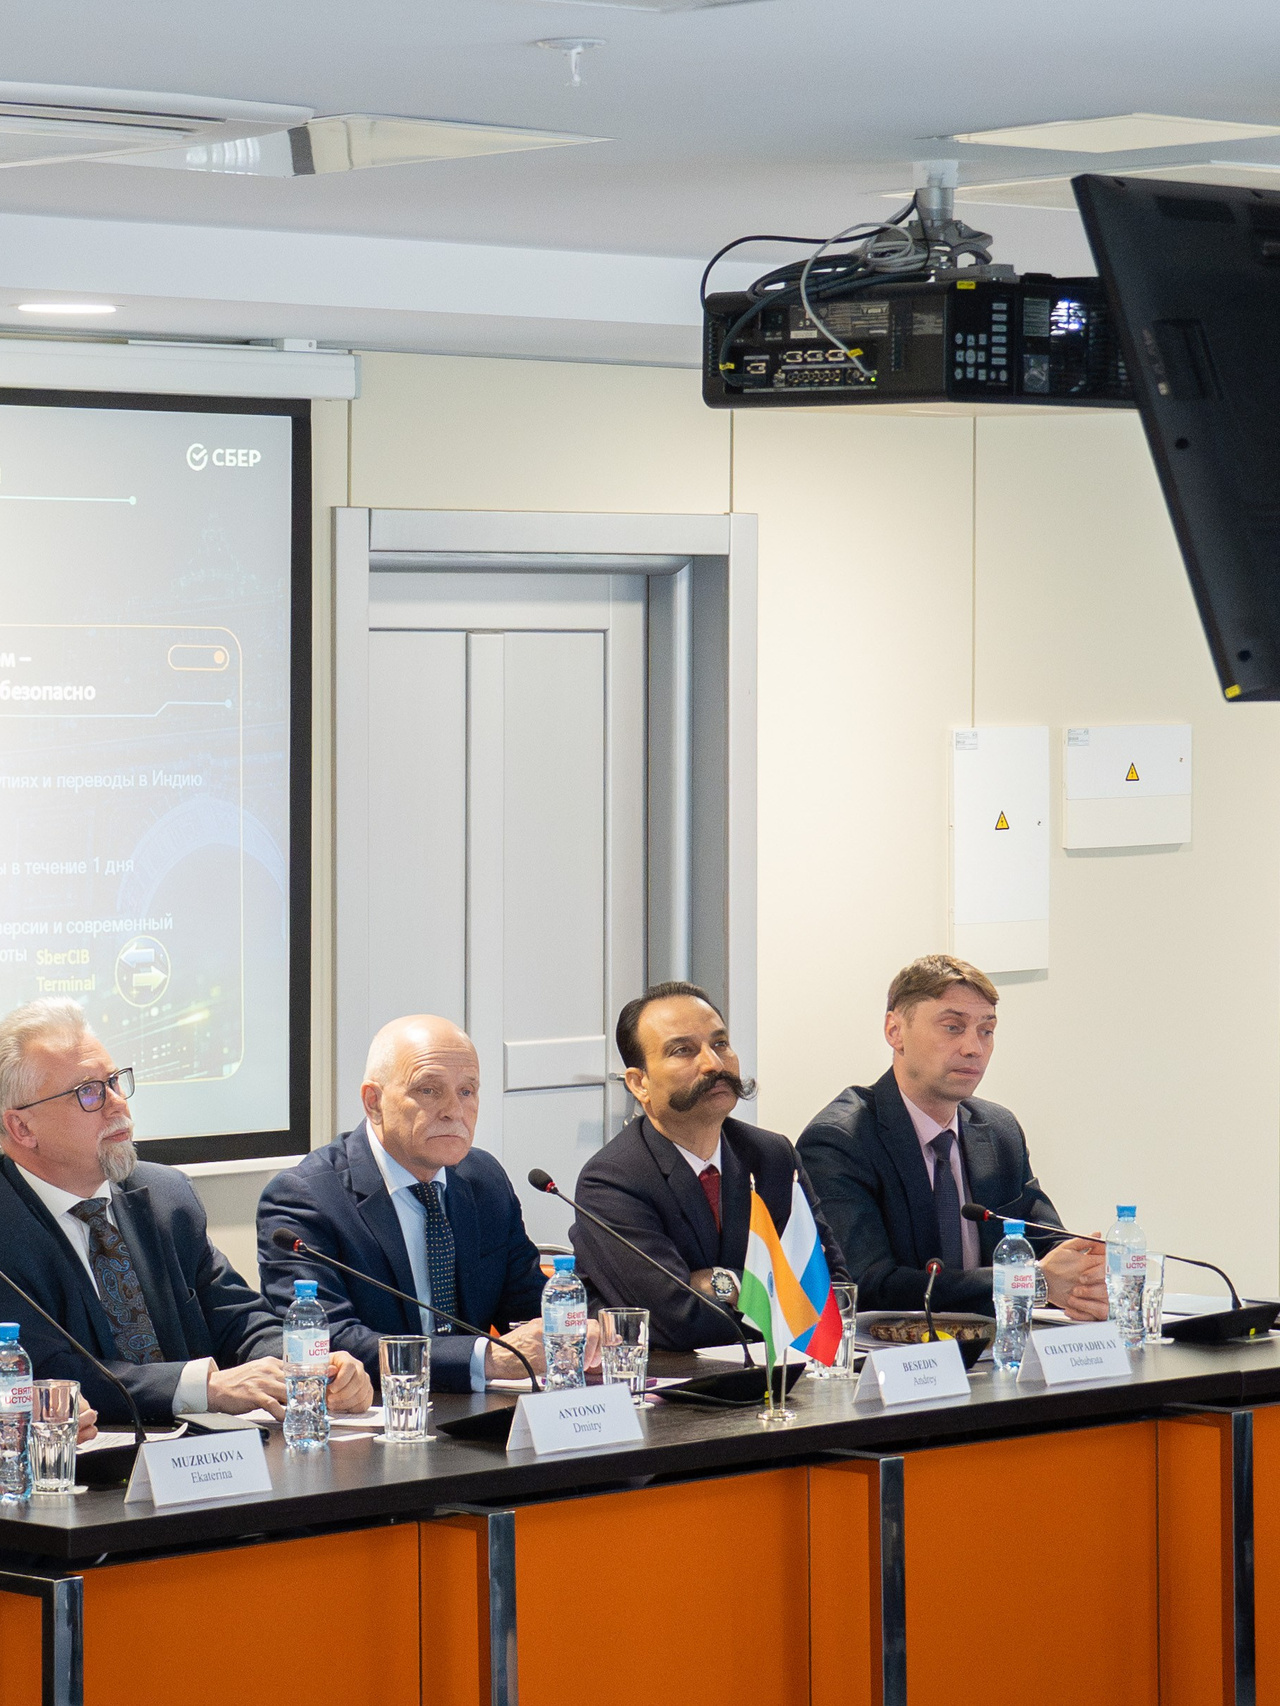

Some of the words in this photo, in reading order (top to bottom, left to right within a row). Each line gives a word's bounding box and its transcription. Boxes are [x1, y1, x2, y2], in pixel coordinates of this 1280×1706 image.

[211, 448, 262, 468] СБЕР
[0, 679, 96, 701] безопасно
[42, 776, 52, 788] и
[56, 773, 135, 793] переводы
[138, 774, 148, 786] в
[152, 769, 202, 788] Индию
[11, 863, 21, 875] в
[24, 859, 87, 875] течение
[92, 856, 101, 874] 1
[104, 858, 135, 876] дня
[53, 922, 62, 934] и
[66, 912, 173, 938] современный
[36, 948, 90, 966] SberCIB
[36, 973, 96, 992] Terminal
[1044, 1340, 1117, 1355] CHATTOPADHYAY
[903, 1358, 938, 1372] BESEDIN
[559, 1403, 606, 1419] ANTONOV
[573, 1420, 602, 1433] Dmitry
[171, 1450, 244, 1469] MUZRUKOVA
[190, 1468, 233, 1484] Ekaterina
